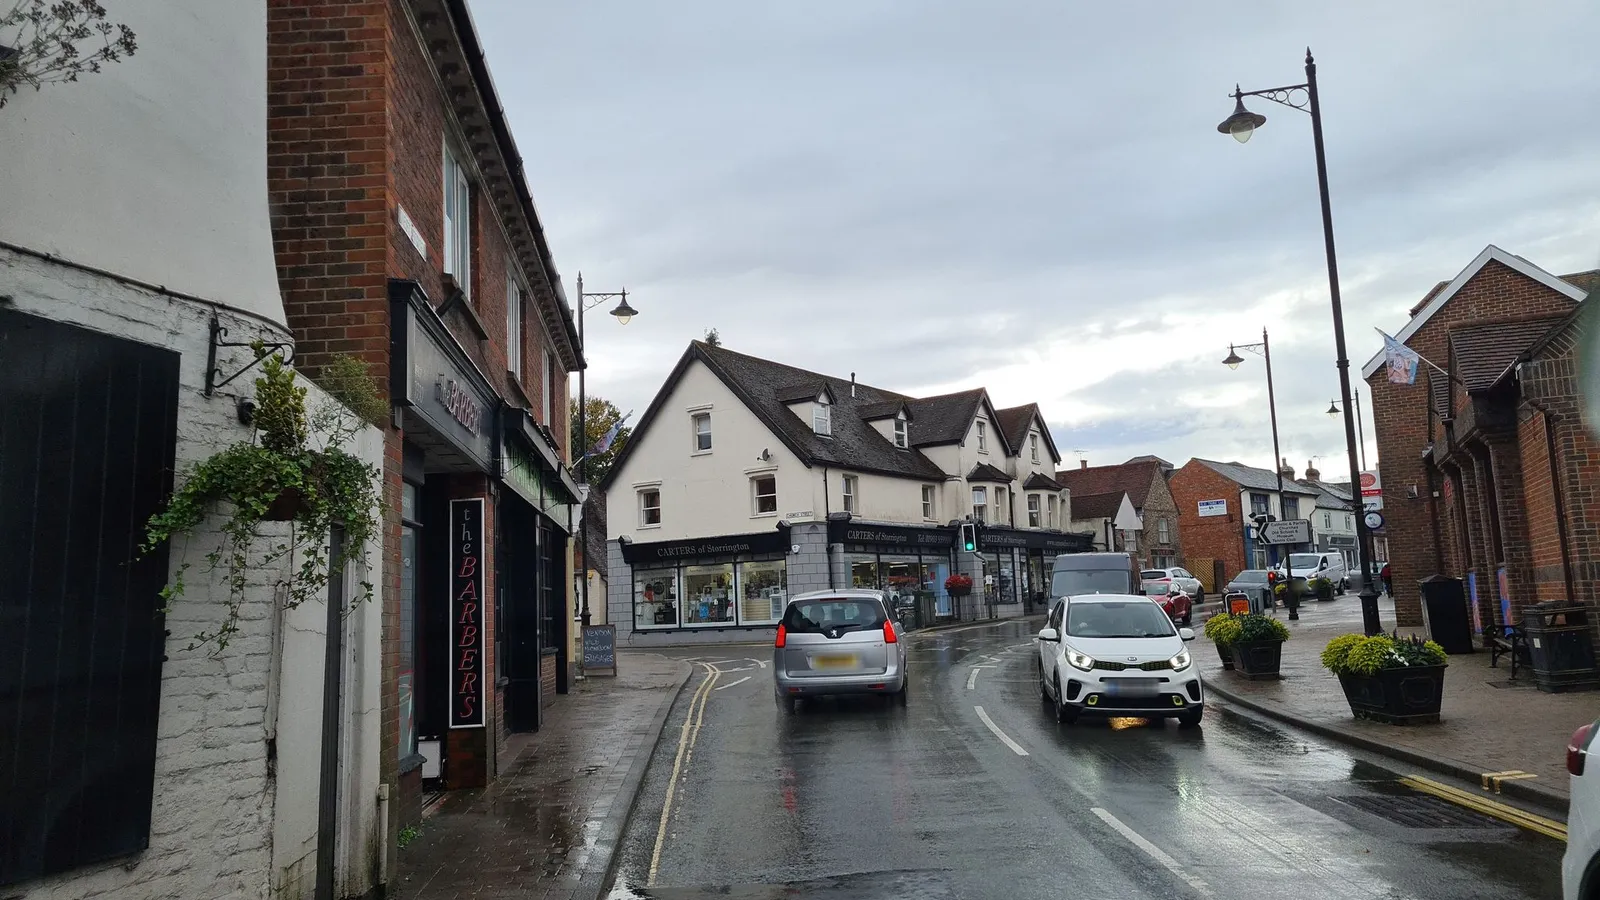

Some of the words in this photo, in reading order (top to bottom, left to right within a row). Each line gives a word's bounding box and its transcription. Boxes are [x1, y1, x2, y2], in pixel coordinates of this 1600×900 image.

[462, 508, 473, 554] the
[847, 530, 875, 540] CARTERS
[875, 532, 881, 540] of
[881, 532, 907, 543] Storrington
[657, 545, 697, 557] CARTERS
[698, 545, 706, 554] of
[707, 543, 750, 553] Storrington
[457, 556, 478, 718] BARBERS
